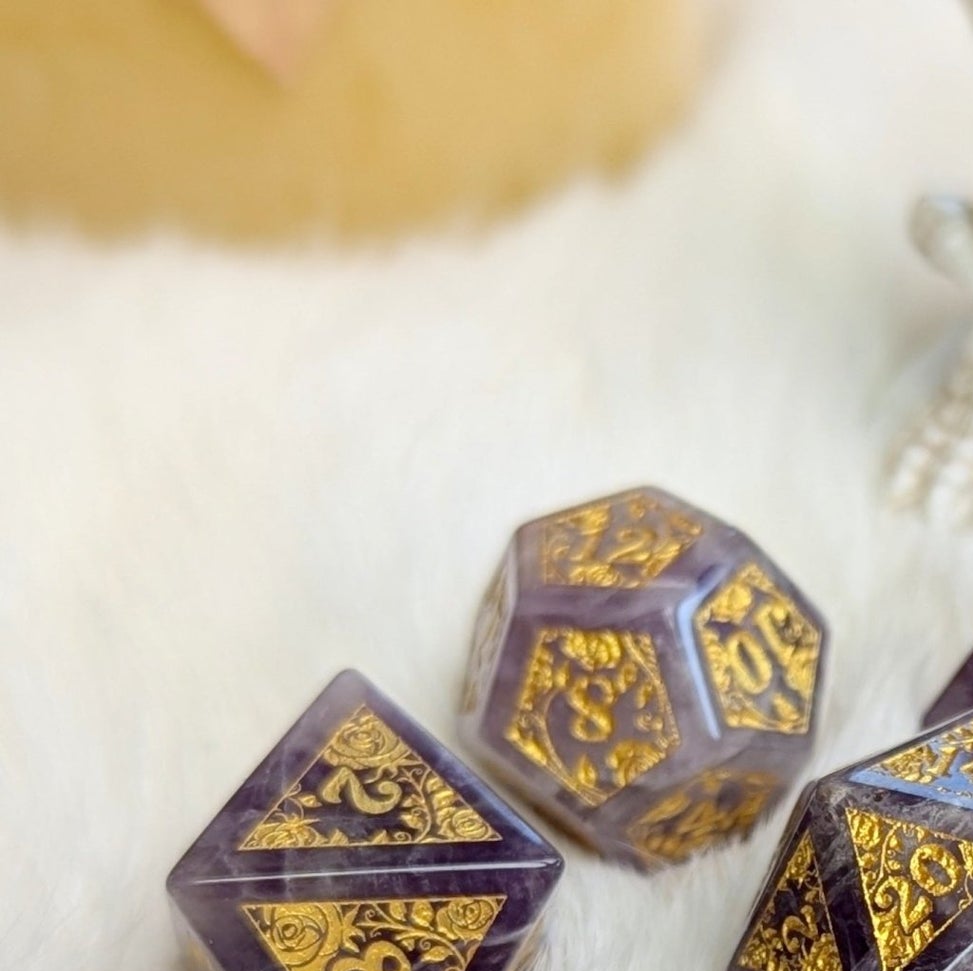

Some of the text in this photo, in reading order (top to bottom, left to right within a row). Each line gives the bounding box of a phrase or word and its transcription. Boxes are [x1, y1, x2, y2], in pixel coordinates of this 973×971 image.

[575, 518, 655, 562] 12
[727, 604, 796, 694] 10
[569, 676, 613, 742] 8
[321, 766, 401, 814] 2
[873, 843, 964, 932] 20
[783, 905, 819, 952] 2
